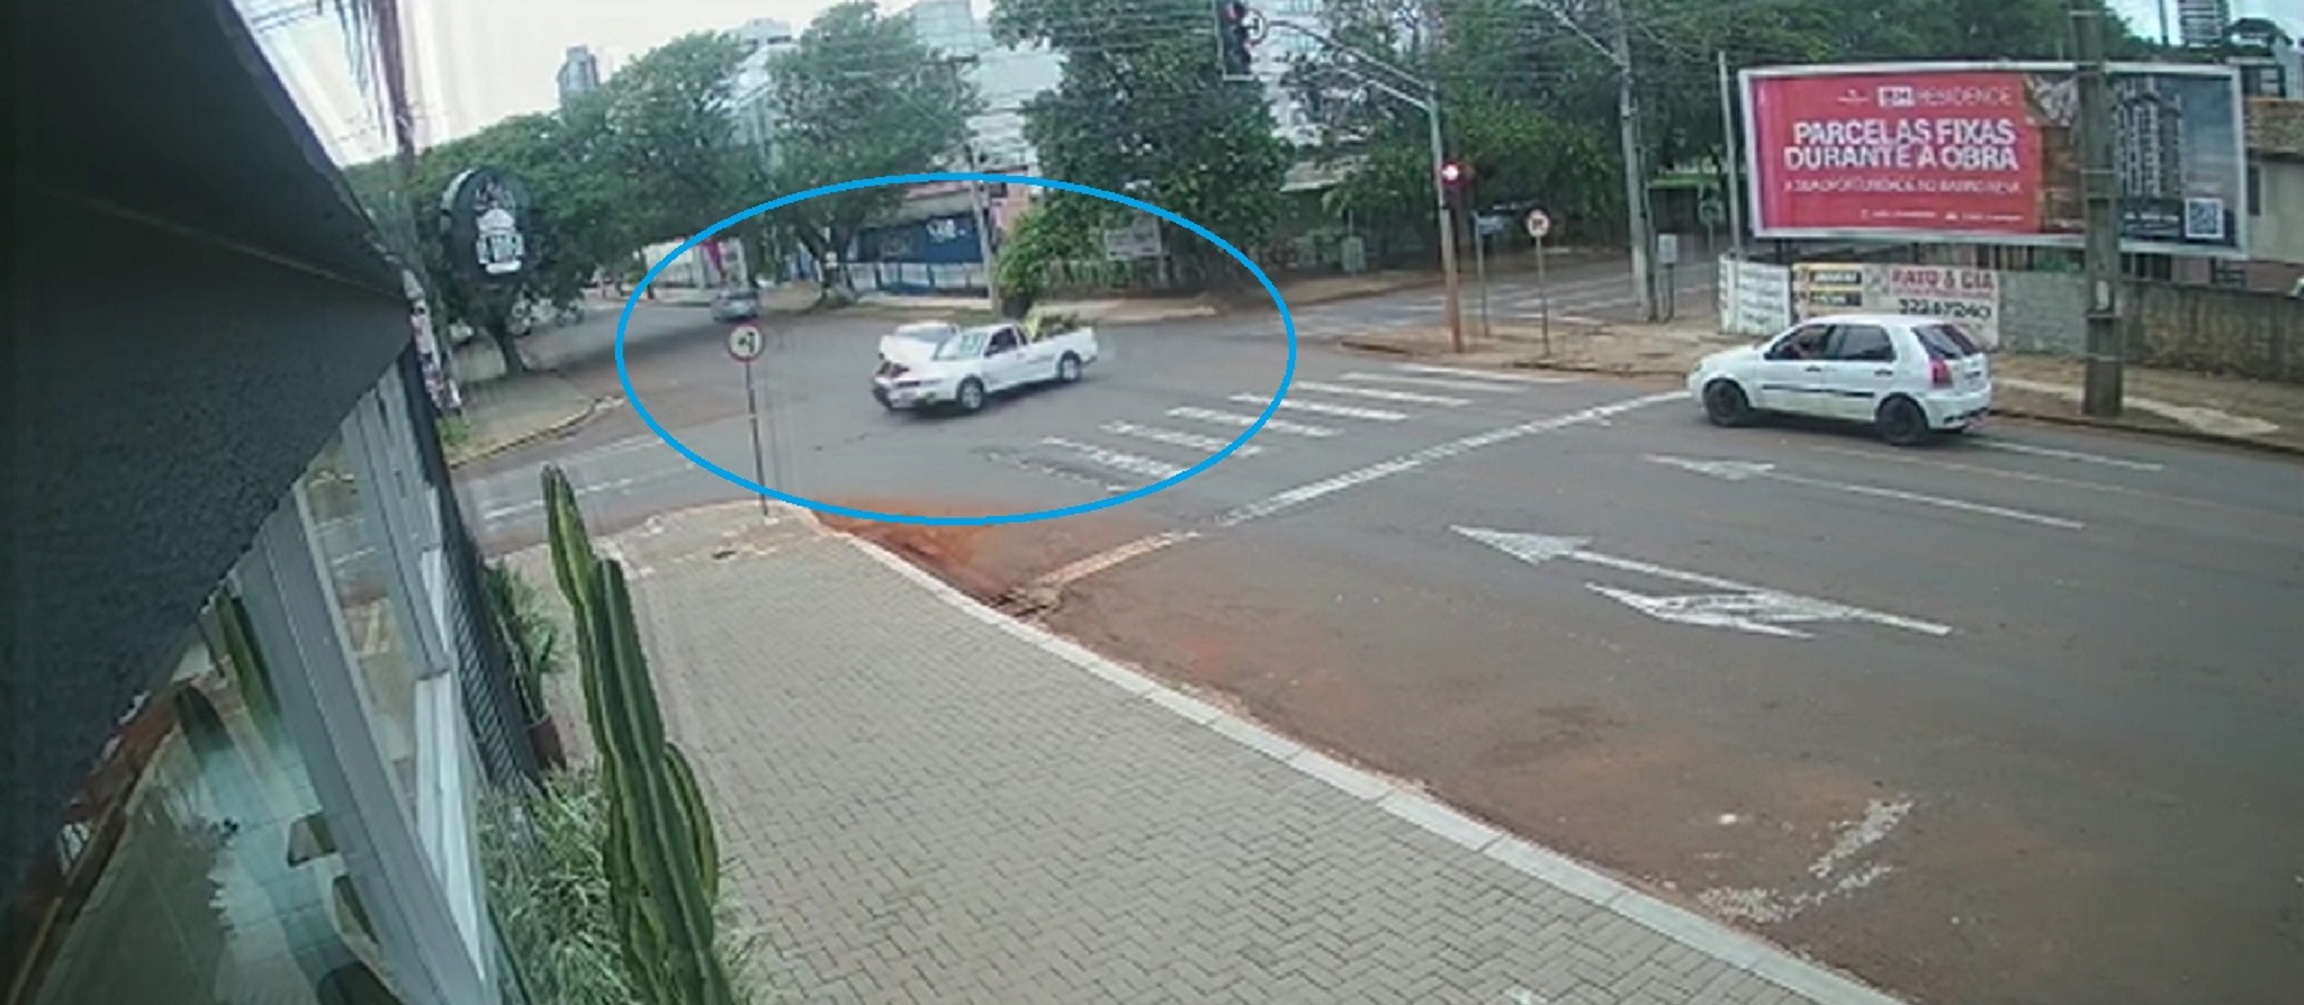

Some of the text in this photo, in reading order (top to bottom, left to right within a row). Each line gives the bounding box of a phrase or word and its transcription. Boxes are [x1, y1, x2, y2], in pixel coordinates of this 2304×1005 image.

[1793, 118, 2017, 145] PARCELAS FIXAS
[1784, 146, 2019, 171] DURANTE A OBRA
[1961, 271, 1994, 289] CIA
